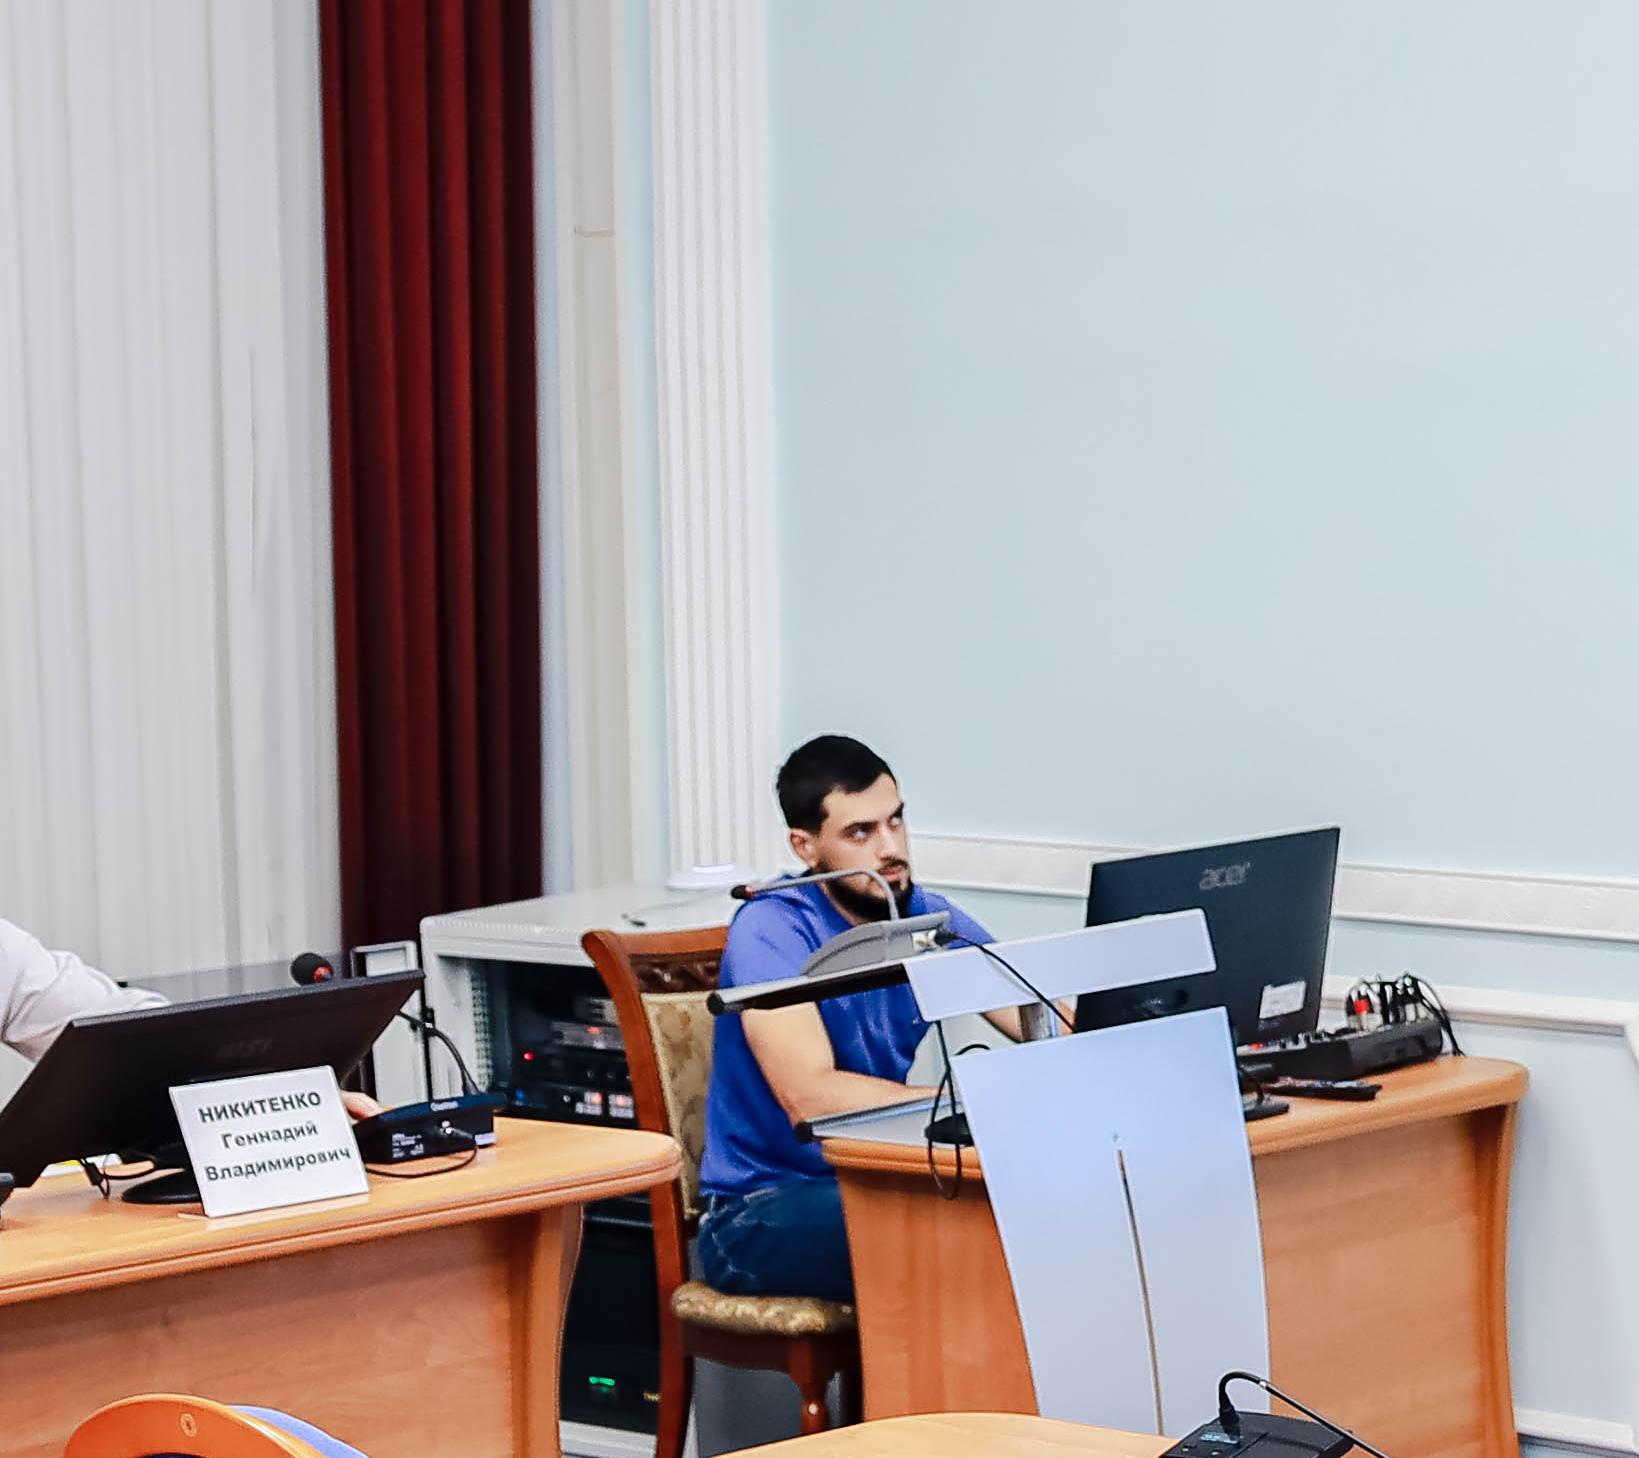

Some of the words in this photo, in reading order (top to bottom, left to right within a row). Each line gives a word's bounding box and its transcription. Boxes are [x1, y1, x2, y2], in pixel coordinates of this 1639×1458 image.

[198, 1091, 321, 1123] НИКИТЕНКО
[221, 1121, 318, 1149] Геннадий
[204, 1147, 351, 1182] Владимирович
